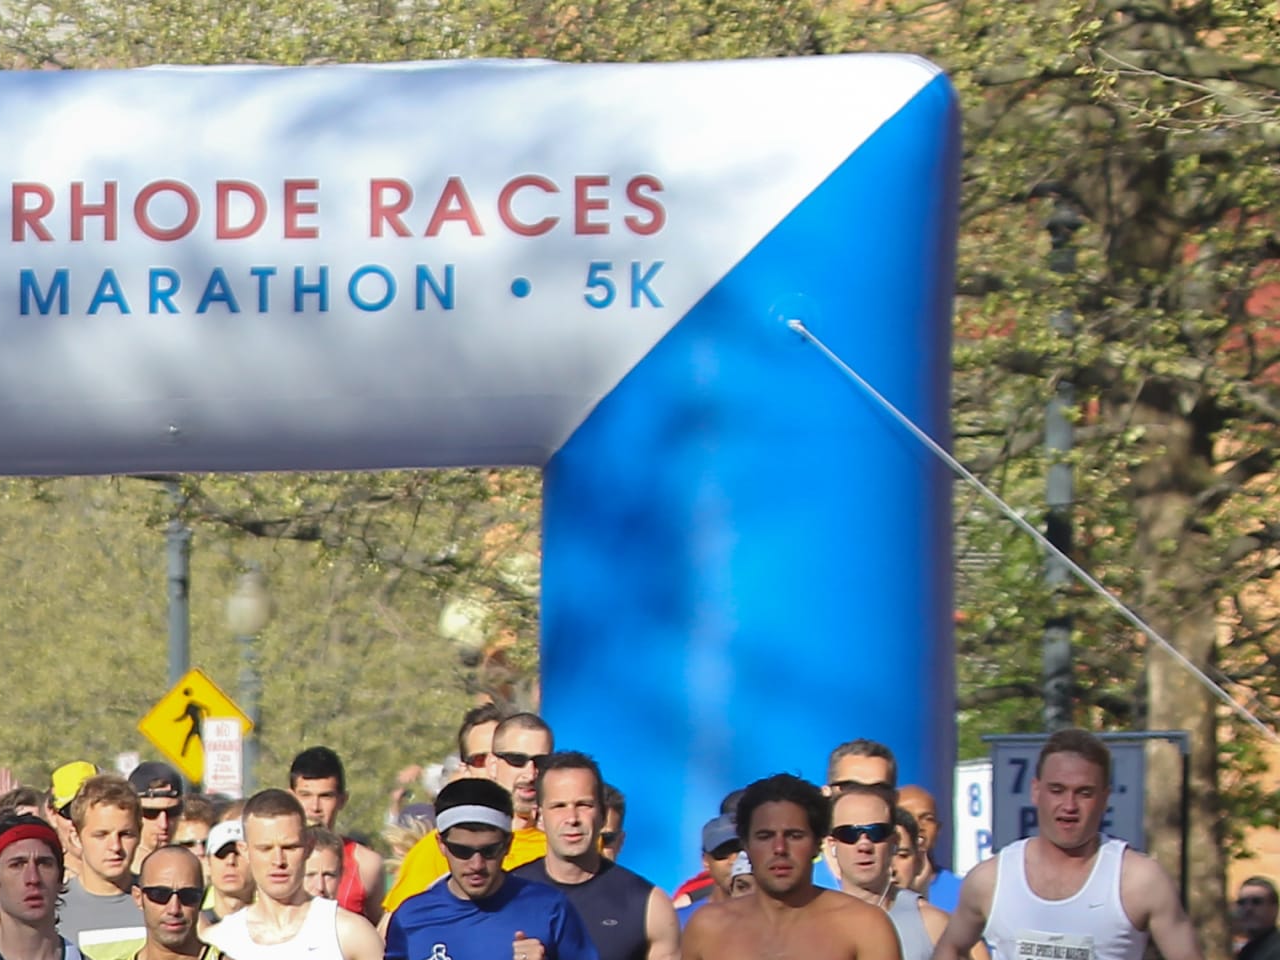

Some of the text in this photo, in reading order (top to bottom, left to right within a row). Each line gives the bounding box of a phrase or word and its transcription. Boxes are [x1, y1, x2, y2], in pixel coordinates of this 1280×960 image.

[11, 179, 319, 242] RHODE
[370, 174, 666, 237] RACES
[20, 264, 454, 315] MARATHON
[584, 261, 665, 309] 5K
